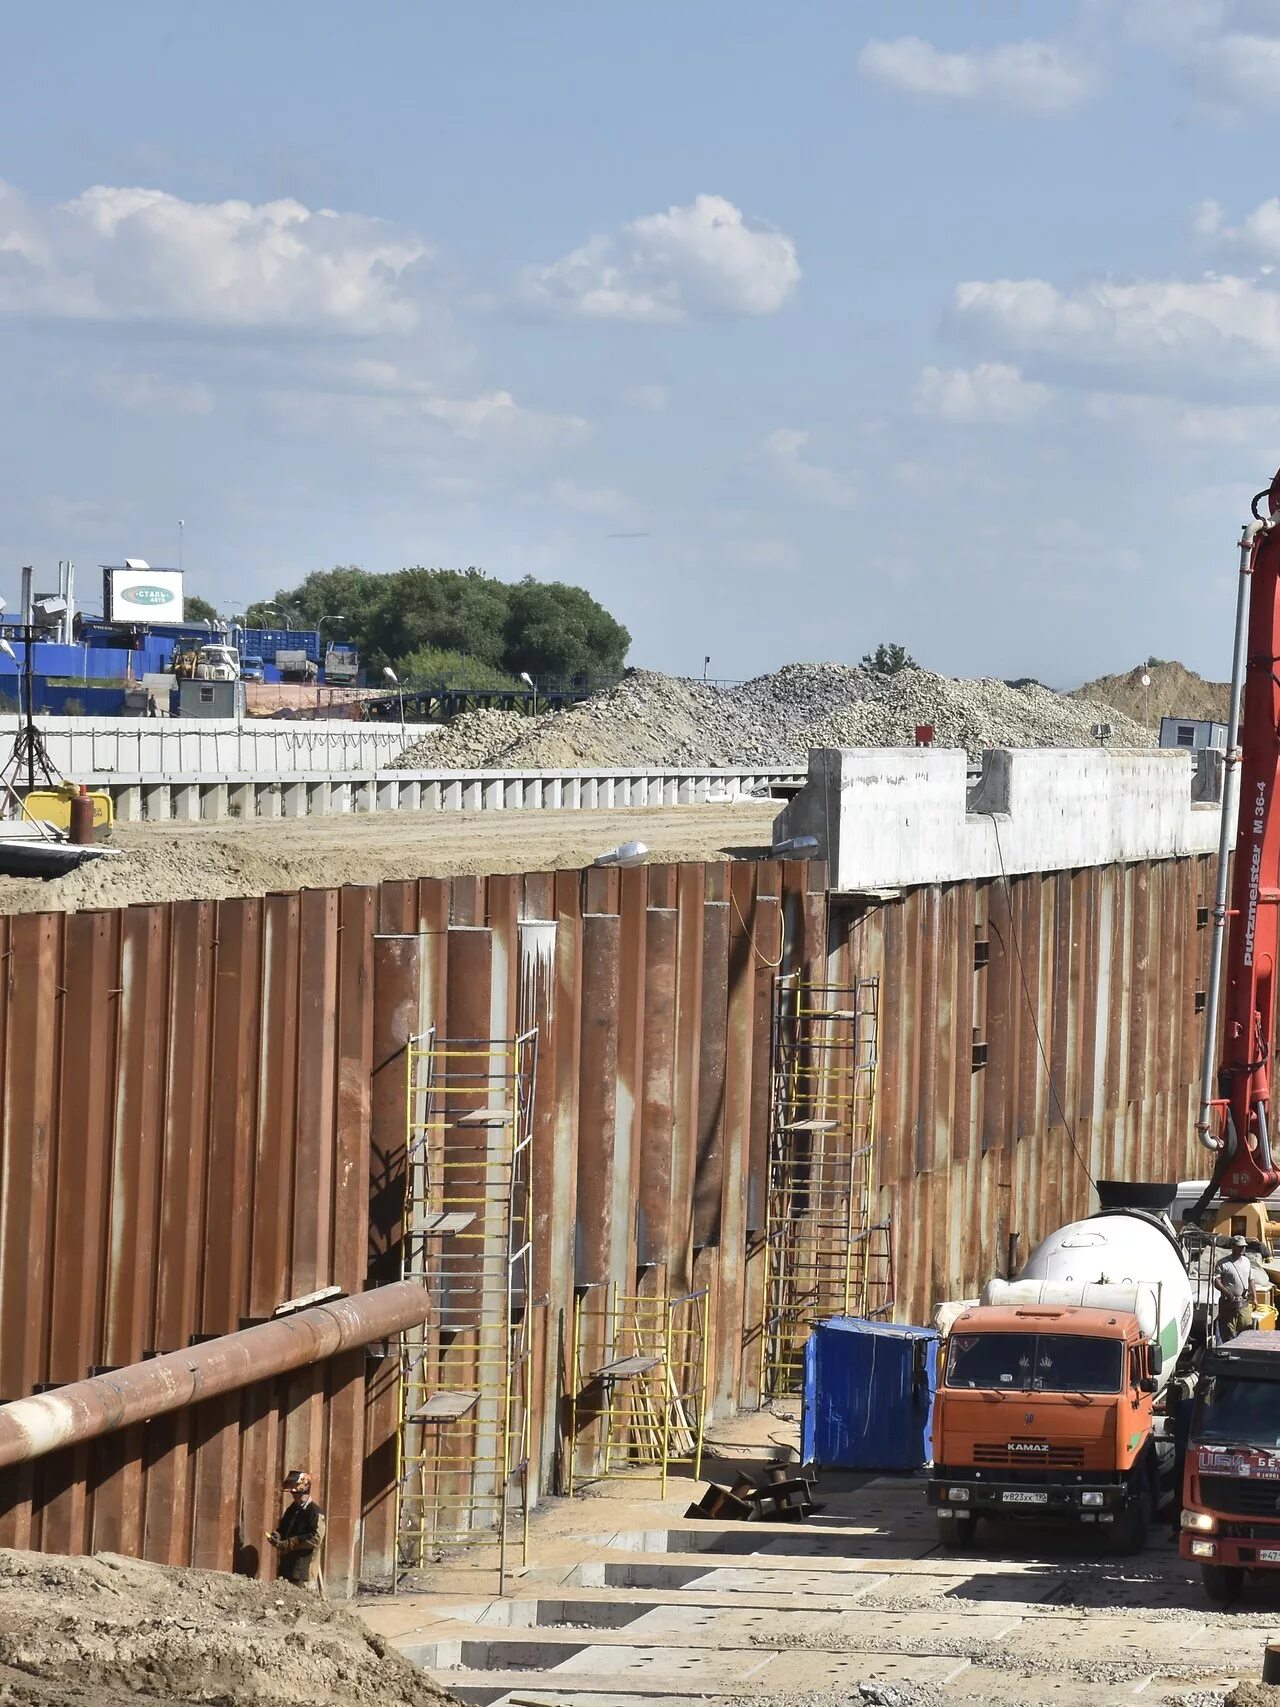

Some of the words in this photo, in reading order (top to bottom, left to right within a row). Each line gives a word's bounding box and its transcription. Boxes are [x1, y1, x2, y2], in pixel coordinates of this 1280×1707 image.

[138, 590, 166, 598] СТАЛЬ
[1254, 781, 1266, 817] 36-4
[1253, 819, 1263, 834] M
[1244, 844, 1261, 967] Putzmeister
[1007, 1443, 1049, 1452] KAMAZ
